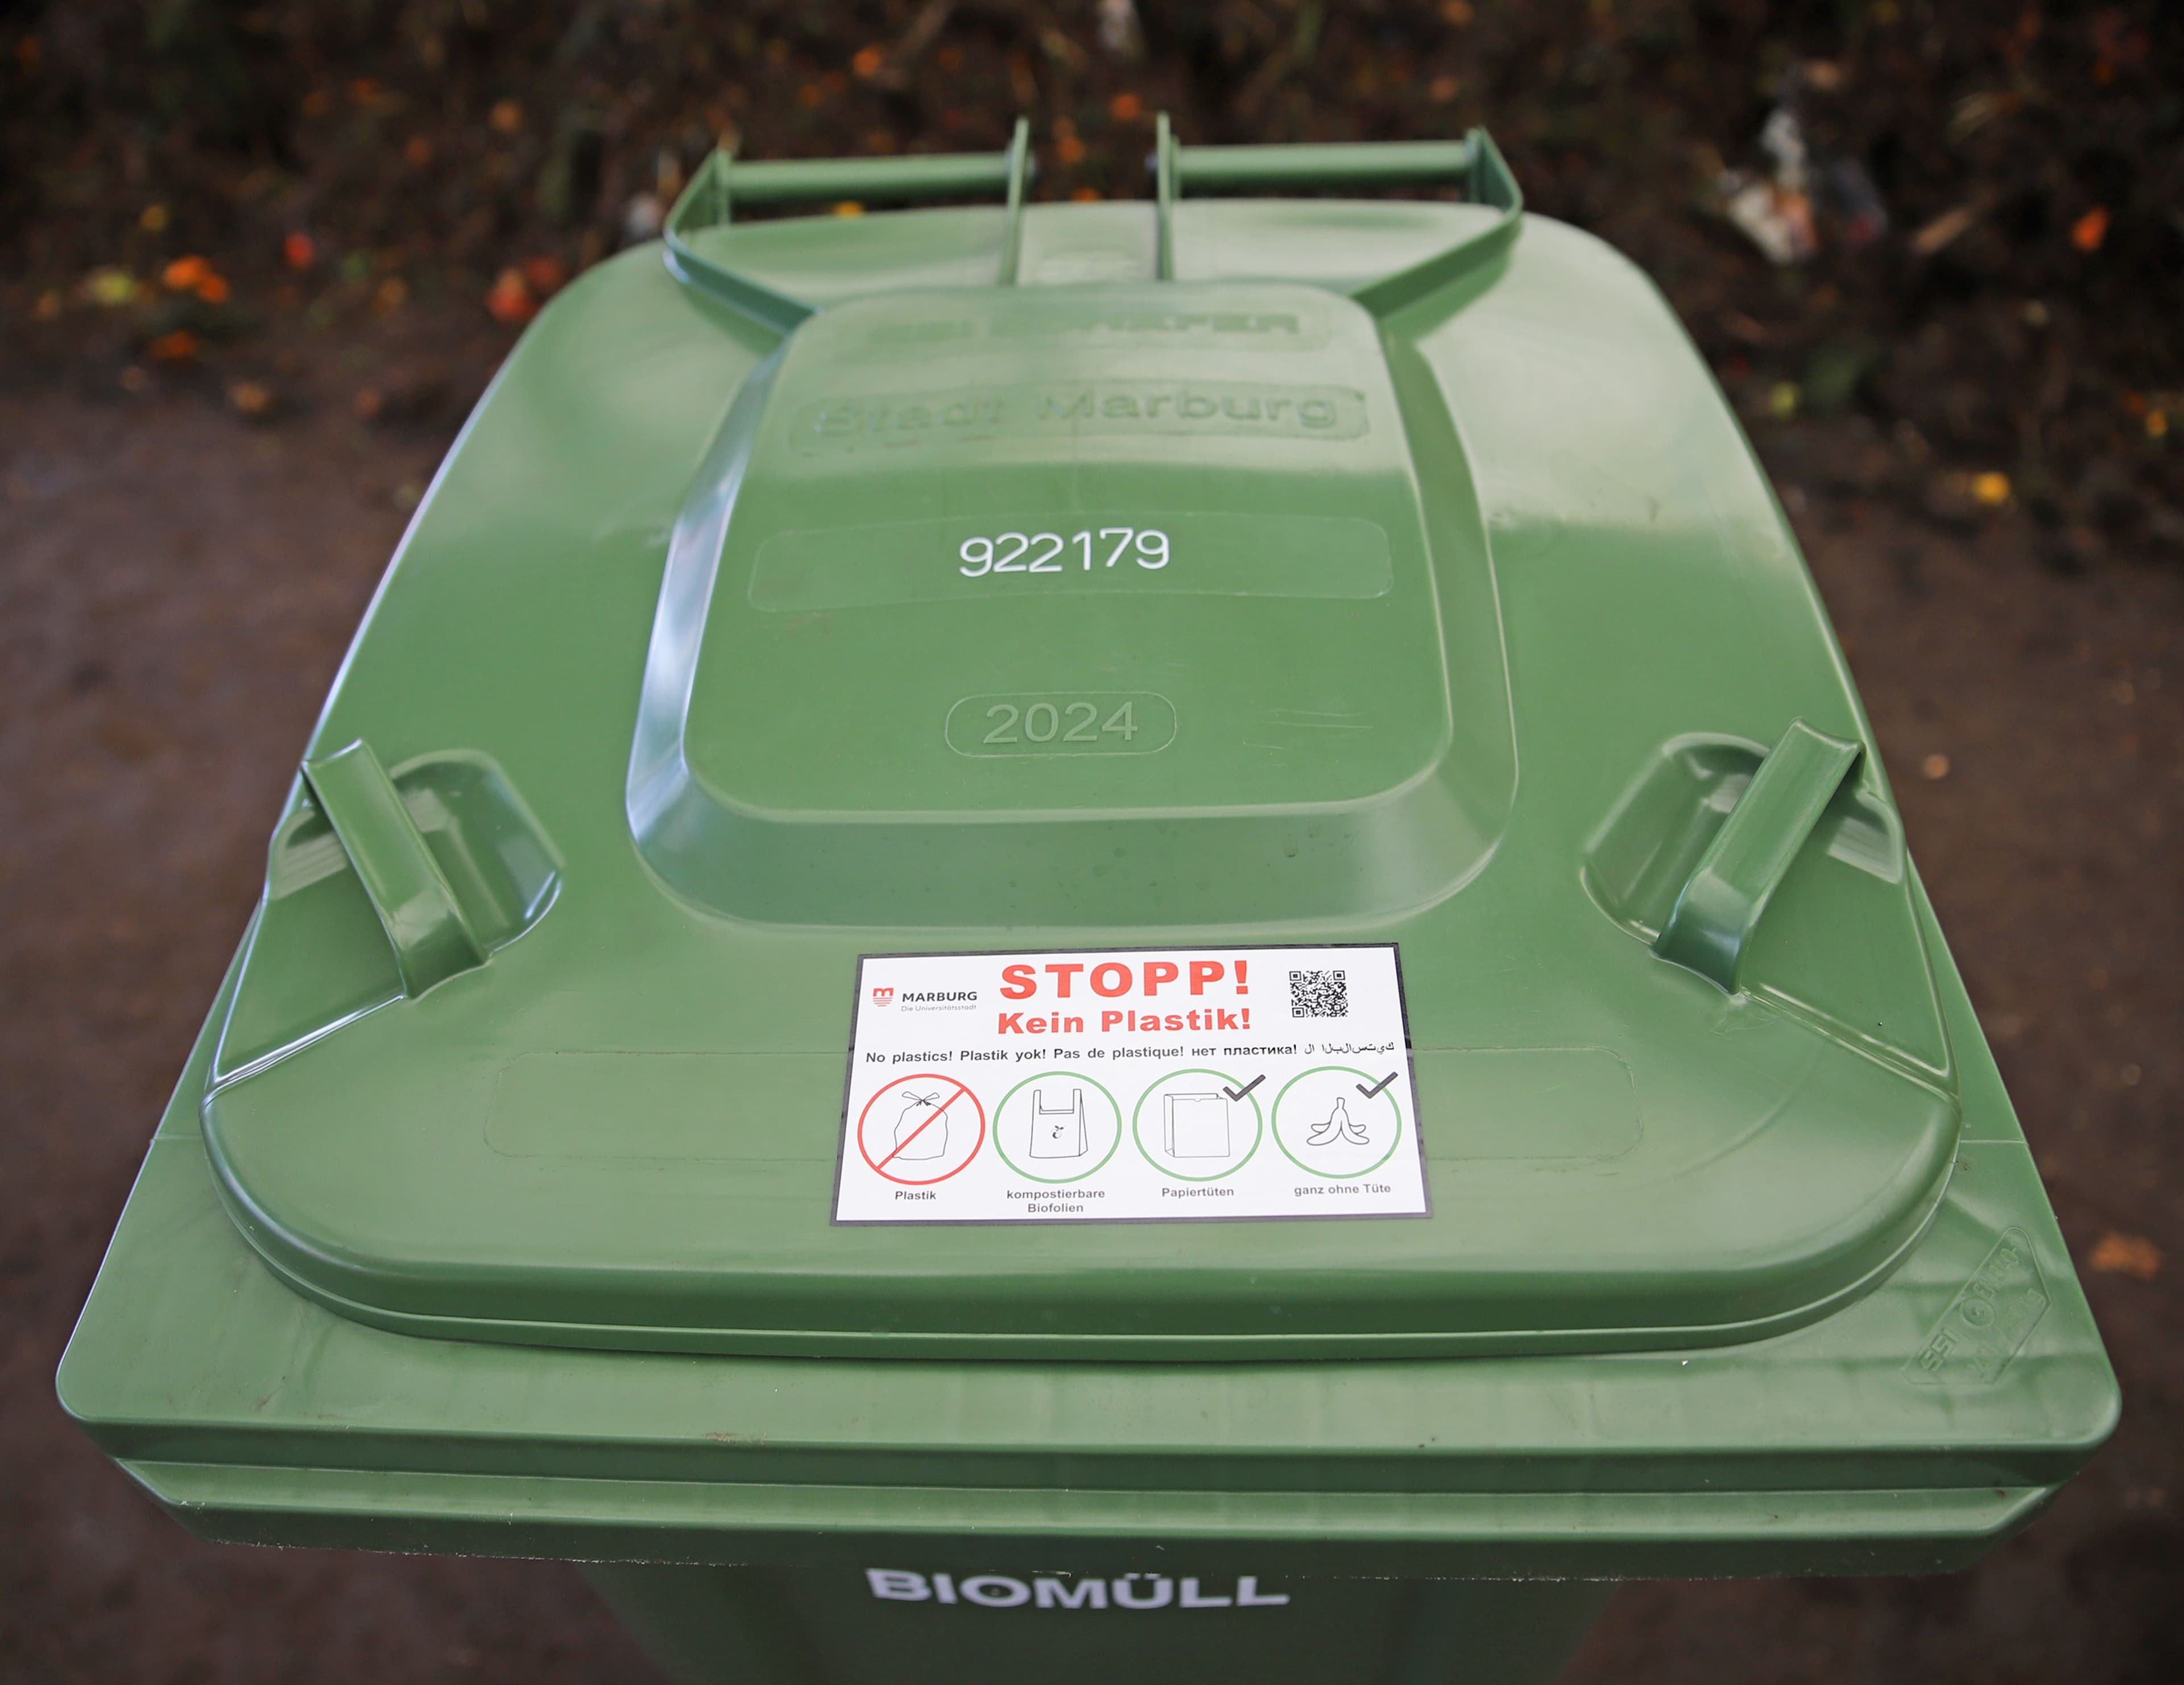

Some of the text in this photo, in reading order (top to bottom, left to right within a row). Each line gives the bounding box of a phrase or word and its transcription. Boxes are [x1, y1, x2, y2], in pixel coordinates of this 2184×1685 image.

[815, 387, 1337, 436] Stadt Marburg
[959, 527, 1170, 577] 922179
[983, 702, 1138, 743] 2024
[1000, 960, 1248, 1000] STOPP!
[902, 991, 978, 1002] MARBURG
[998, 1008, 1250, 1034] Kein Plastik!
[866, 1052, 886, 1063] No
[892, 1051, 952, 1065] plastics!
[960, 1050, 1008, 1061] Plastik
[1015, 1049, 1046, 1062] yok!
[1054, 1048, 1080, 1059] Pas
[1087, 1048, 1105, 1058] de
[1112, 1046, 1184, 1061] plastique!
[1192, 1047, 1217, 1056] нет
[1223, 1044, 1297, 1055] пластика!
[895, 1191, 936, 1200] Plastik
[1007, 1189, 1105, 1201] kompostierbare
[1161, 1187, 1234, 1199] Papiertüten
[1294, 1183, 1391, 1197] ganz ohne Tüte
[1027, 1203, 1084, 1213] Biofolien
[1920, 1327, 1959, 1372] SSI
[865, 1567, 1290, 1609] BIOMÜLL
